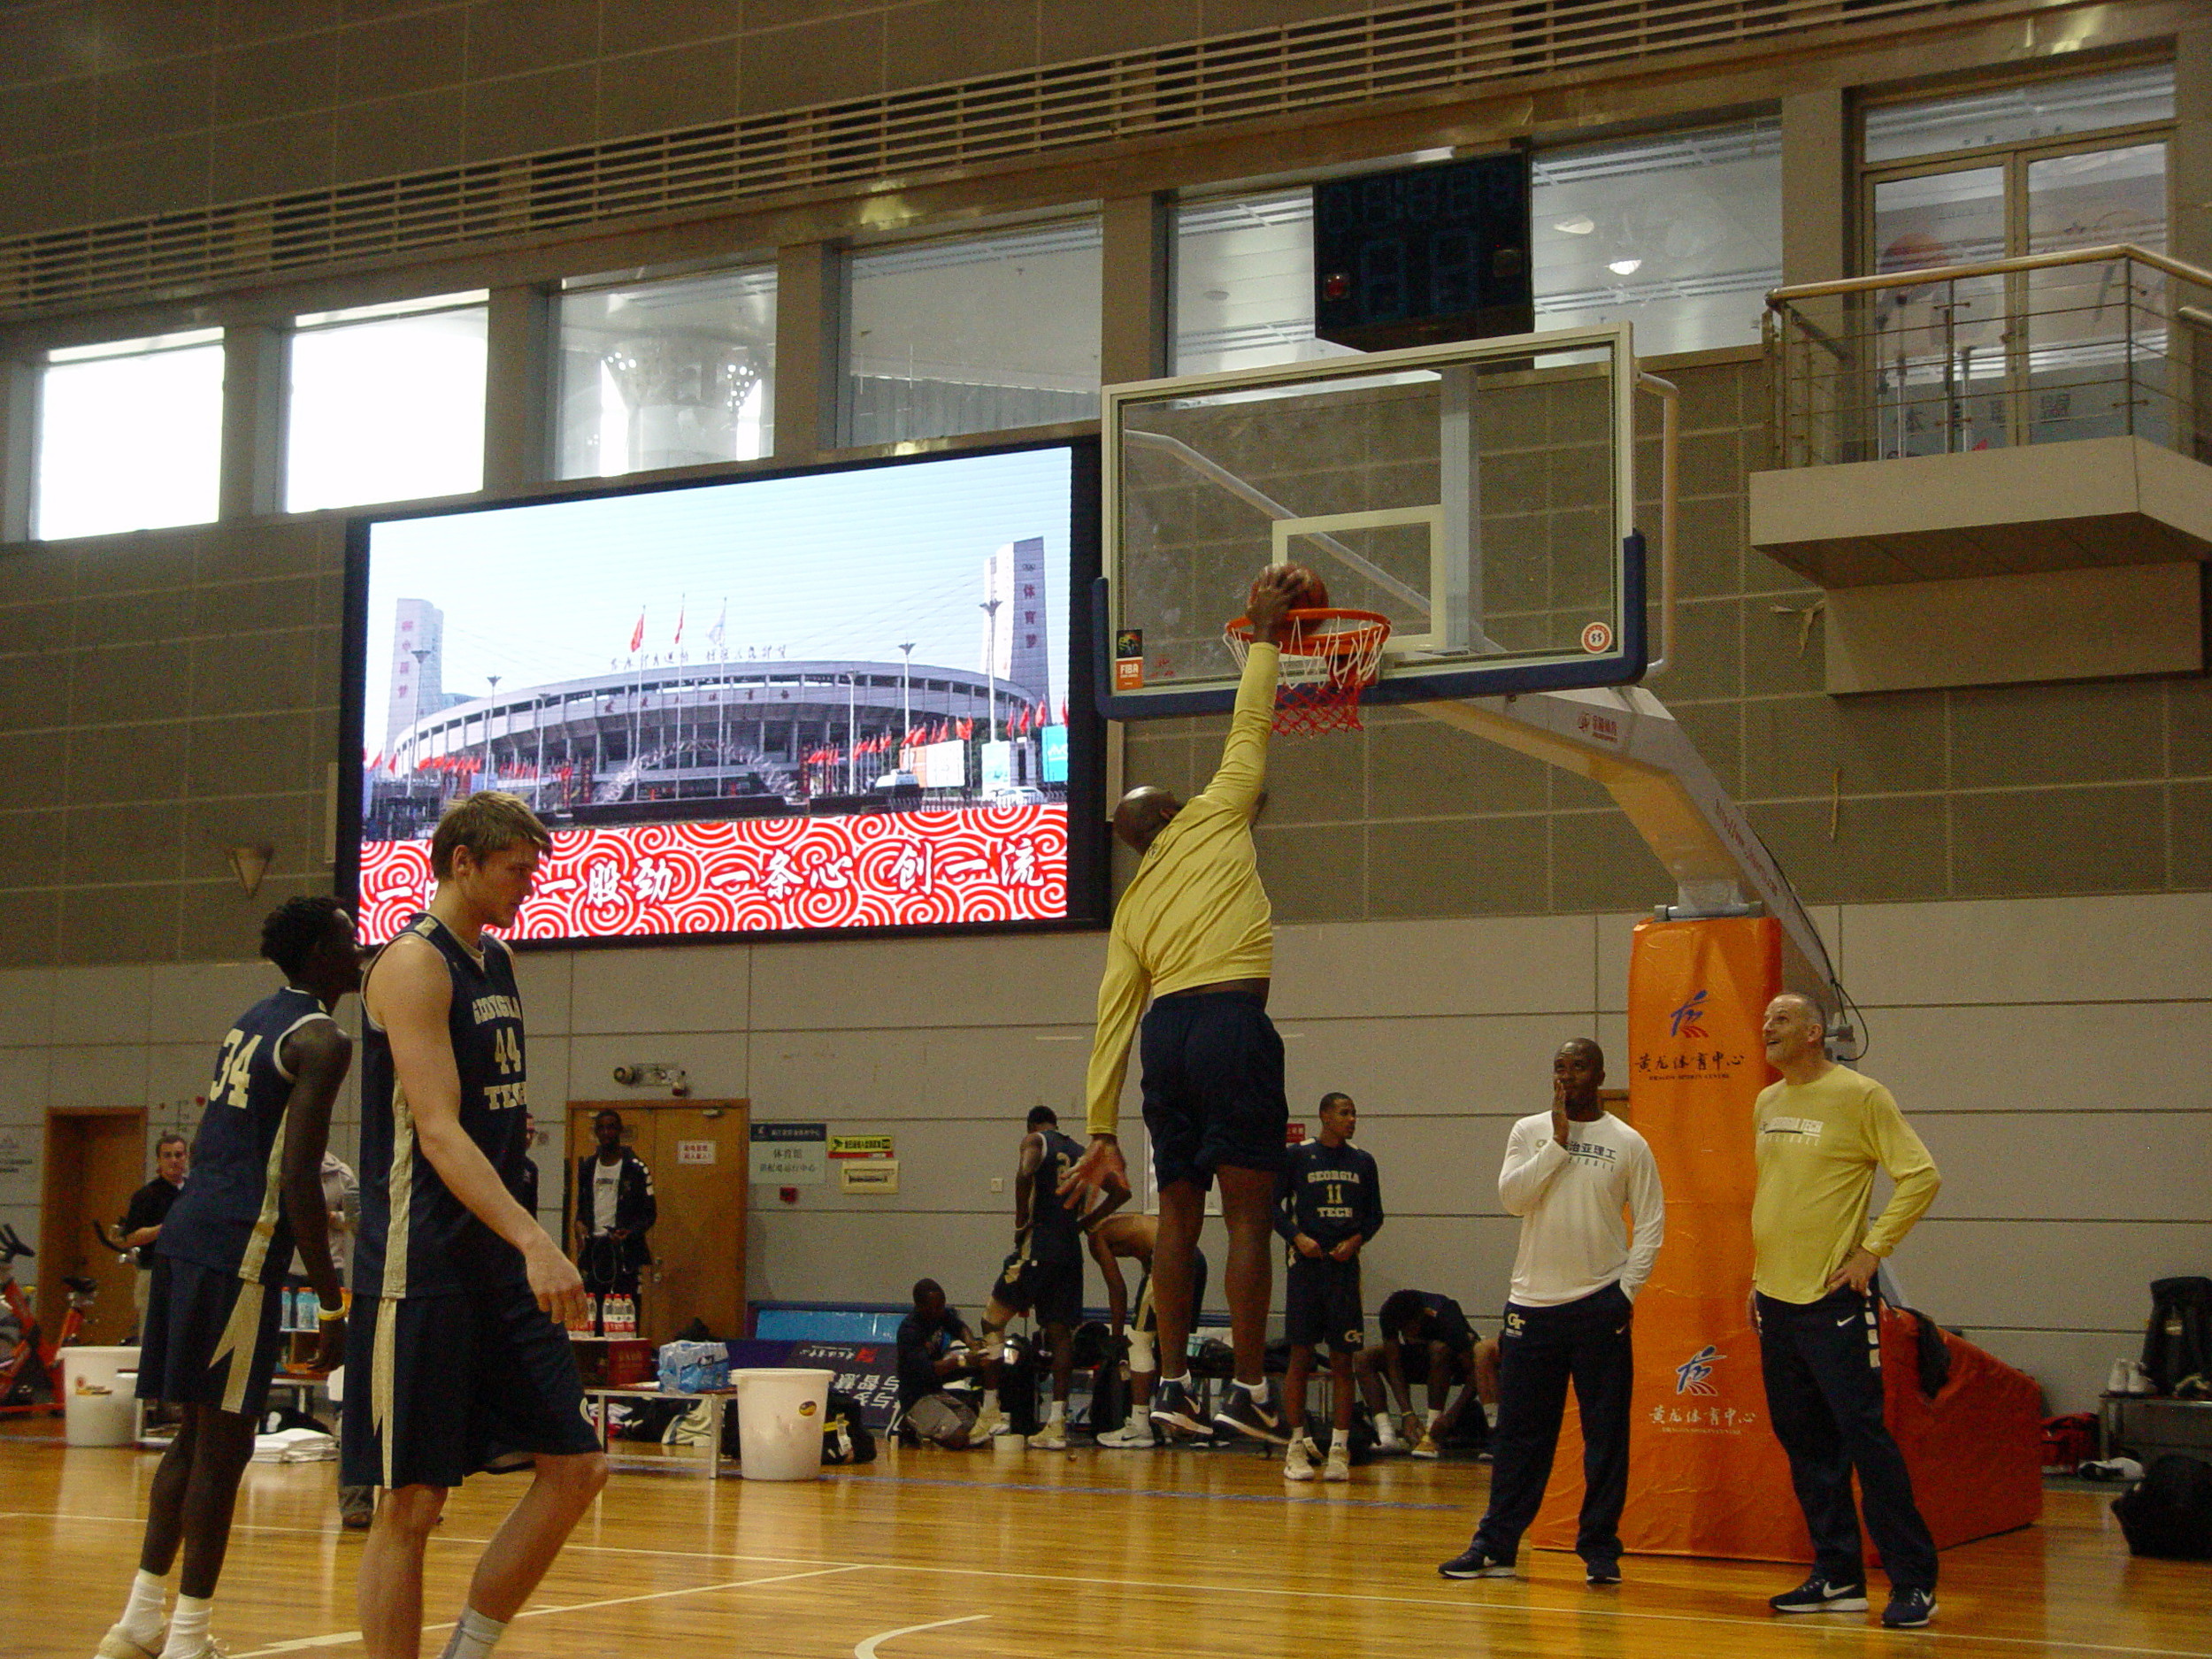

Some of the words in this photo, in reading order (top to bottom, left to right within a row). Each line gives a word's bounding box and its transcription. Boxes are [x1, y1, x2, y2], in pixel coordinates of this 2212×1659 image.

[1120, 664, 1139, 675] FIBA
[538, 857, 673, 909] 一股劲
[710, 849, 854, 900] 一条心
[886, 837, 1046, 895] 创一流
[495, 1026, 521, 1075] 44
[210, 1028, 264, 1110] 34
[1634, 1051, 1746, 1073] 黄龙体育中心
[1307, 1170, 1360, 1184] GEORGIA
[1326, 1184, 1343, 1204] 11
[1317, 1207, 1353, 1218] TECH
[1648, 1404, 1756, 1427] 黄龙体育中心
